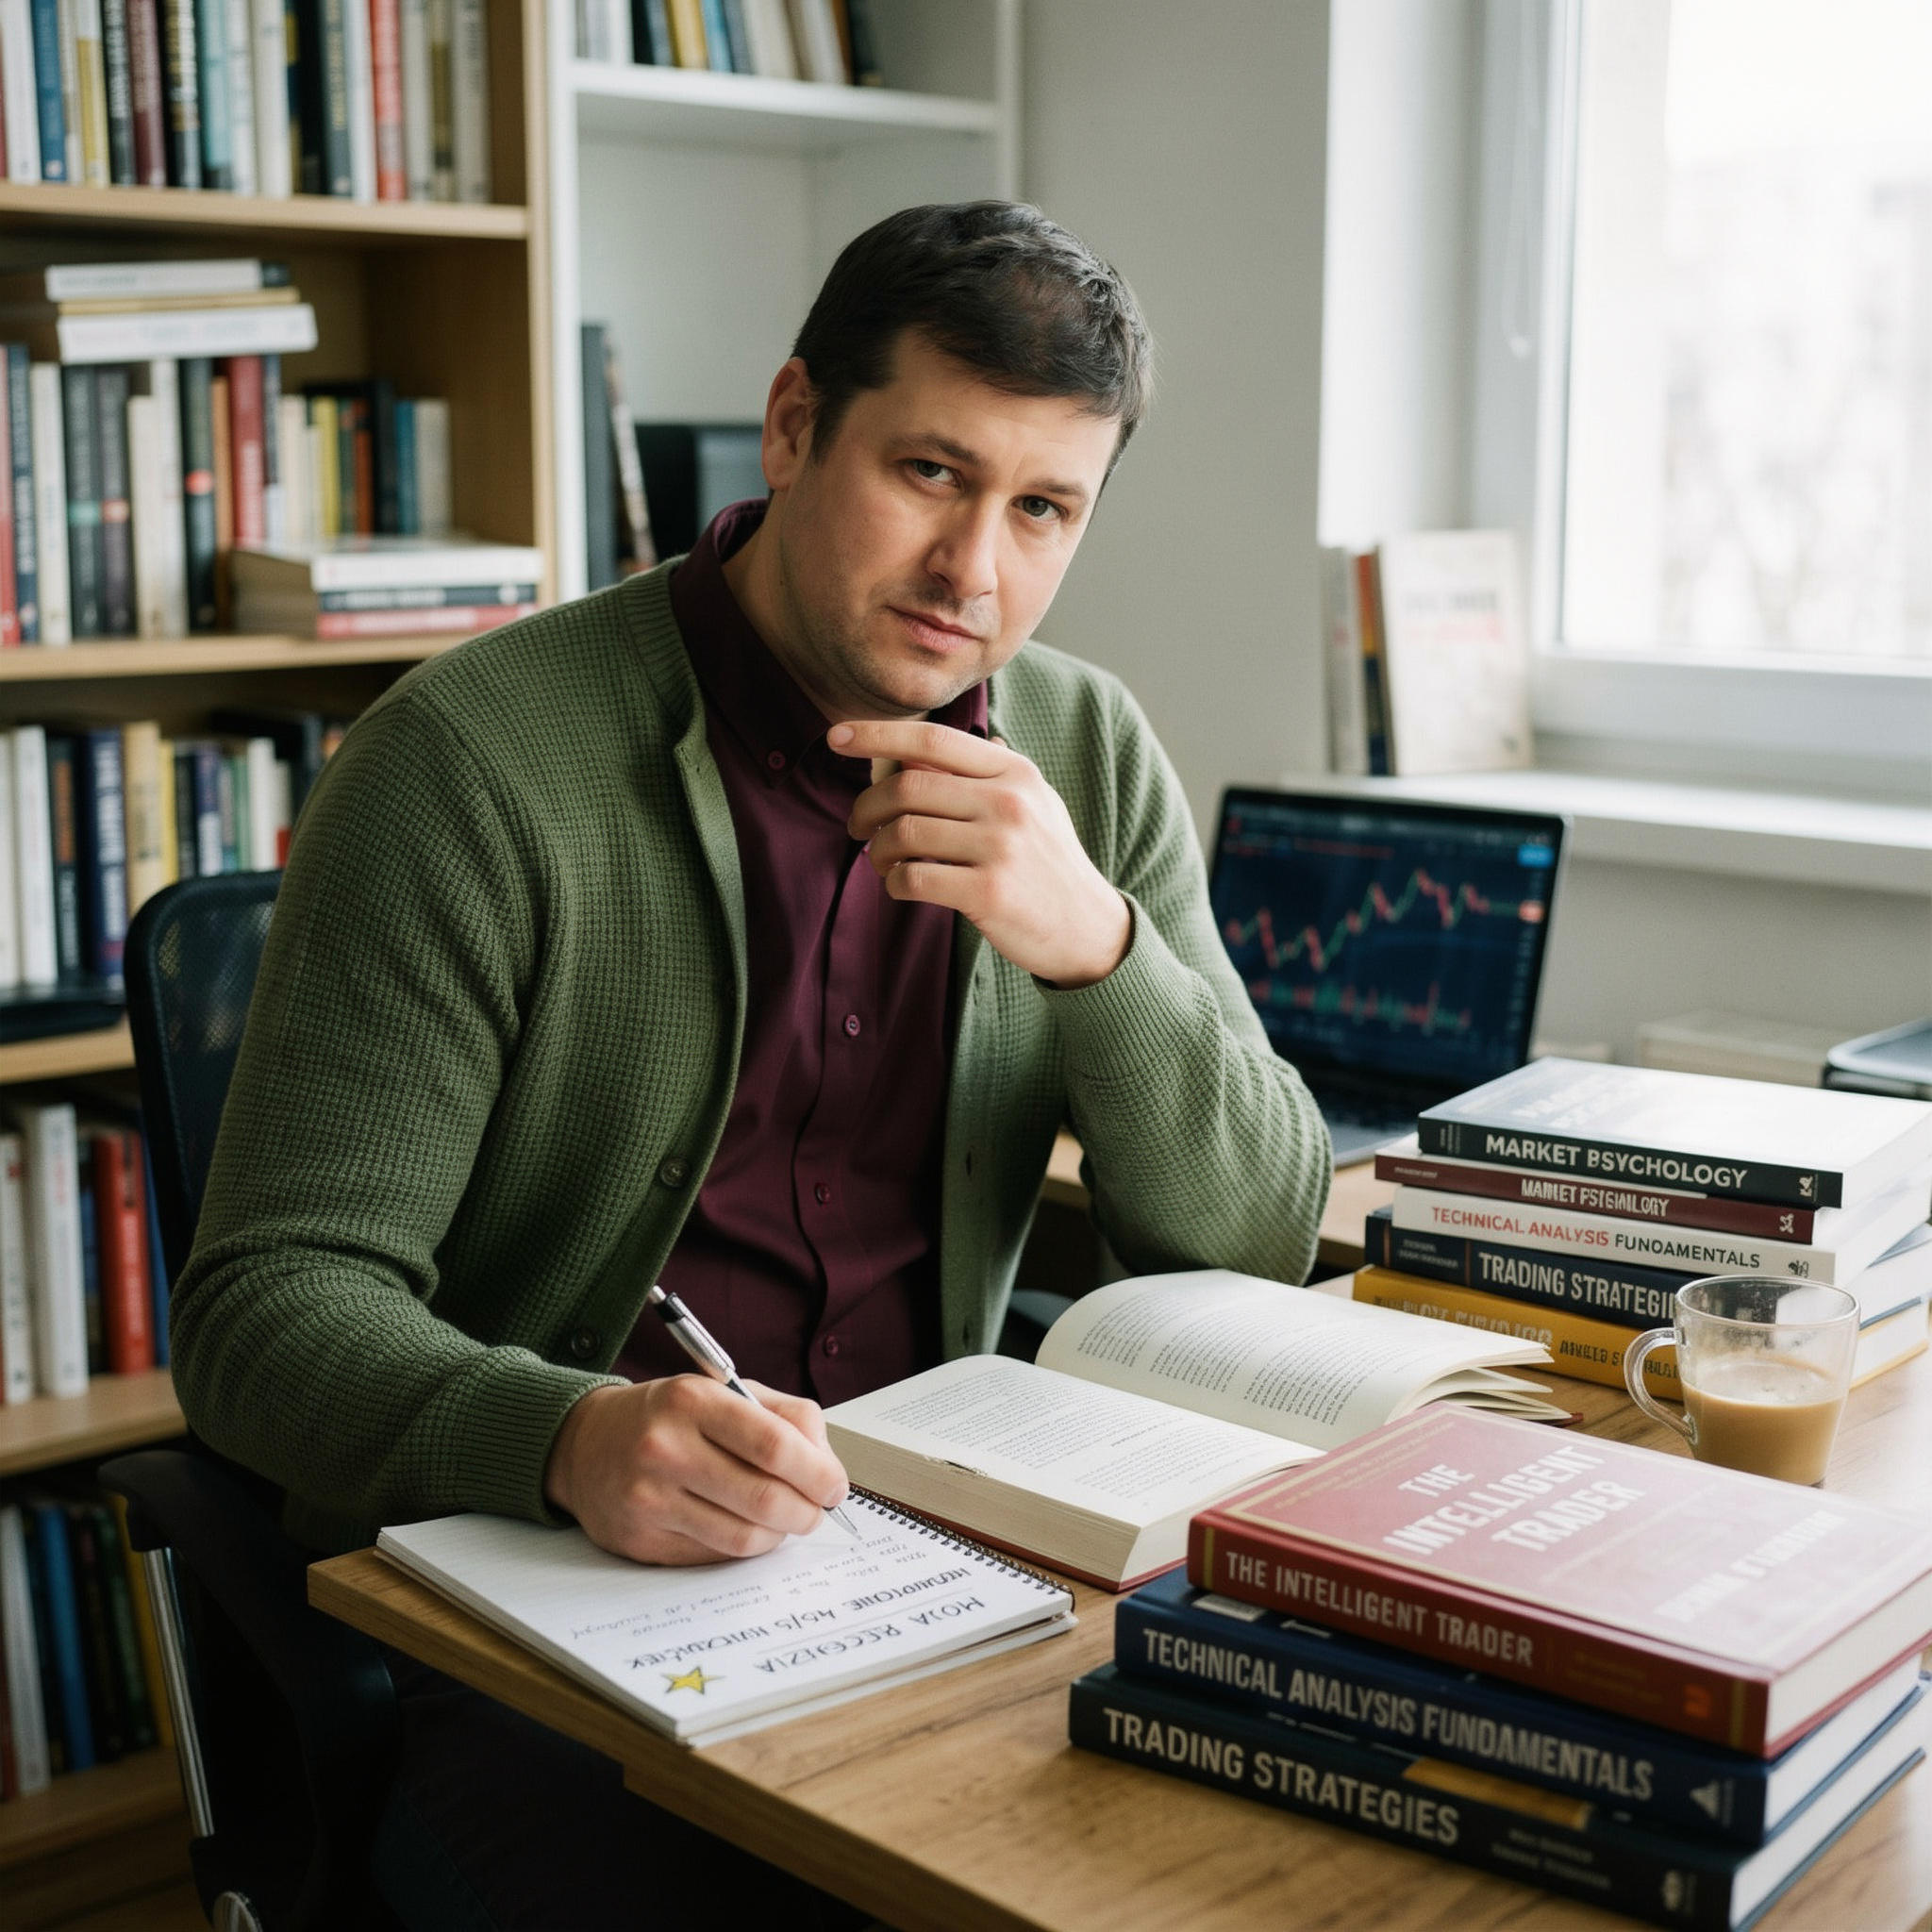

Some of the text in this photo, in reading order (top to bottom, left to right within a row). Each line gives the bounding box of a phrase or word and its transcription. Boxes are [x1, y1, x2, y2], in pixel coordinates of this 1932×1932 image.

[1485, 1133, 1581, 1168] MARKET
[1431, 1207, 1525, 1235] TECHNICAL
[1477, 1251, 1567, 1297] TRADING
[1382, 1445, 1607, 1557] INTELLIGENT
[1396, 1463, 1476, 1499] THE
[1490, 1479, 1648, 1553] TRADER
[1226, 1551, 1535, 1669] THE INTELLIGENT TRADER
[1141, 1627, 1655, 1802] TECHNICAL ANALYSIS FUNDAMENTALS
[1103, 1707, 1460, 1849] TRADING STRATEGIES
